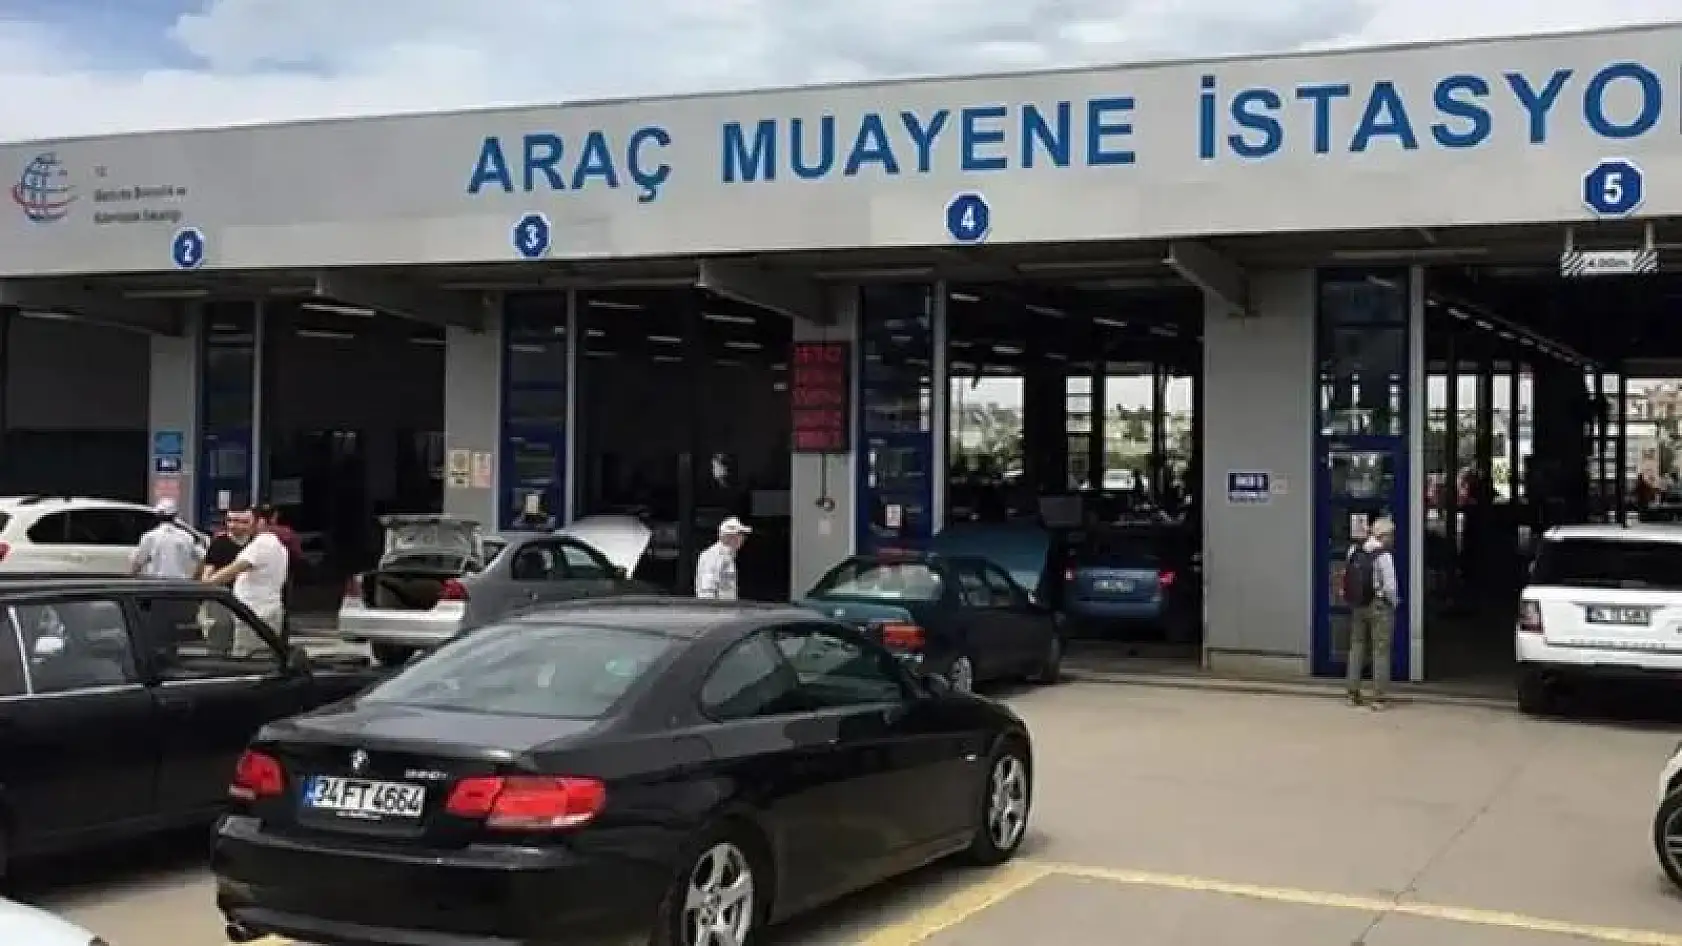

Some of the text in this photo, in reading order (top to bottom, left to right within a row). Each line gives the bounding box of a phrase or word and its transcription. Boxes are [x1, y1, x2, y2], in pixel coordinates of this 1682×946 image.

[467, 62, 1682, 203] ARAÇ MUAYENE İSTASYO
[1603, 171, 1623, 205] 5
[960, 204, 977, 231] 4
[340, 780, 371, 808] FT
